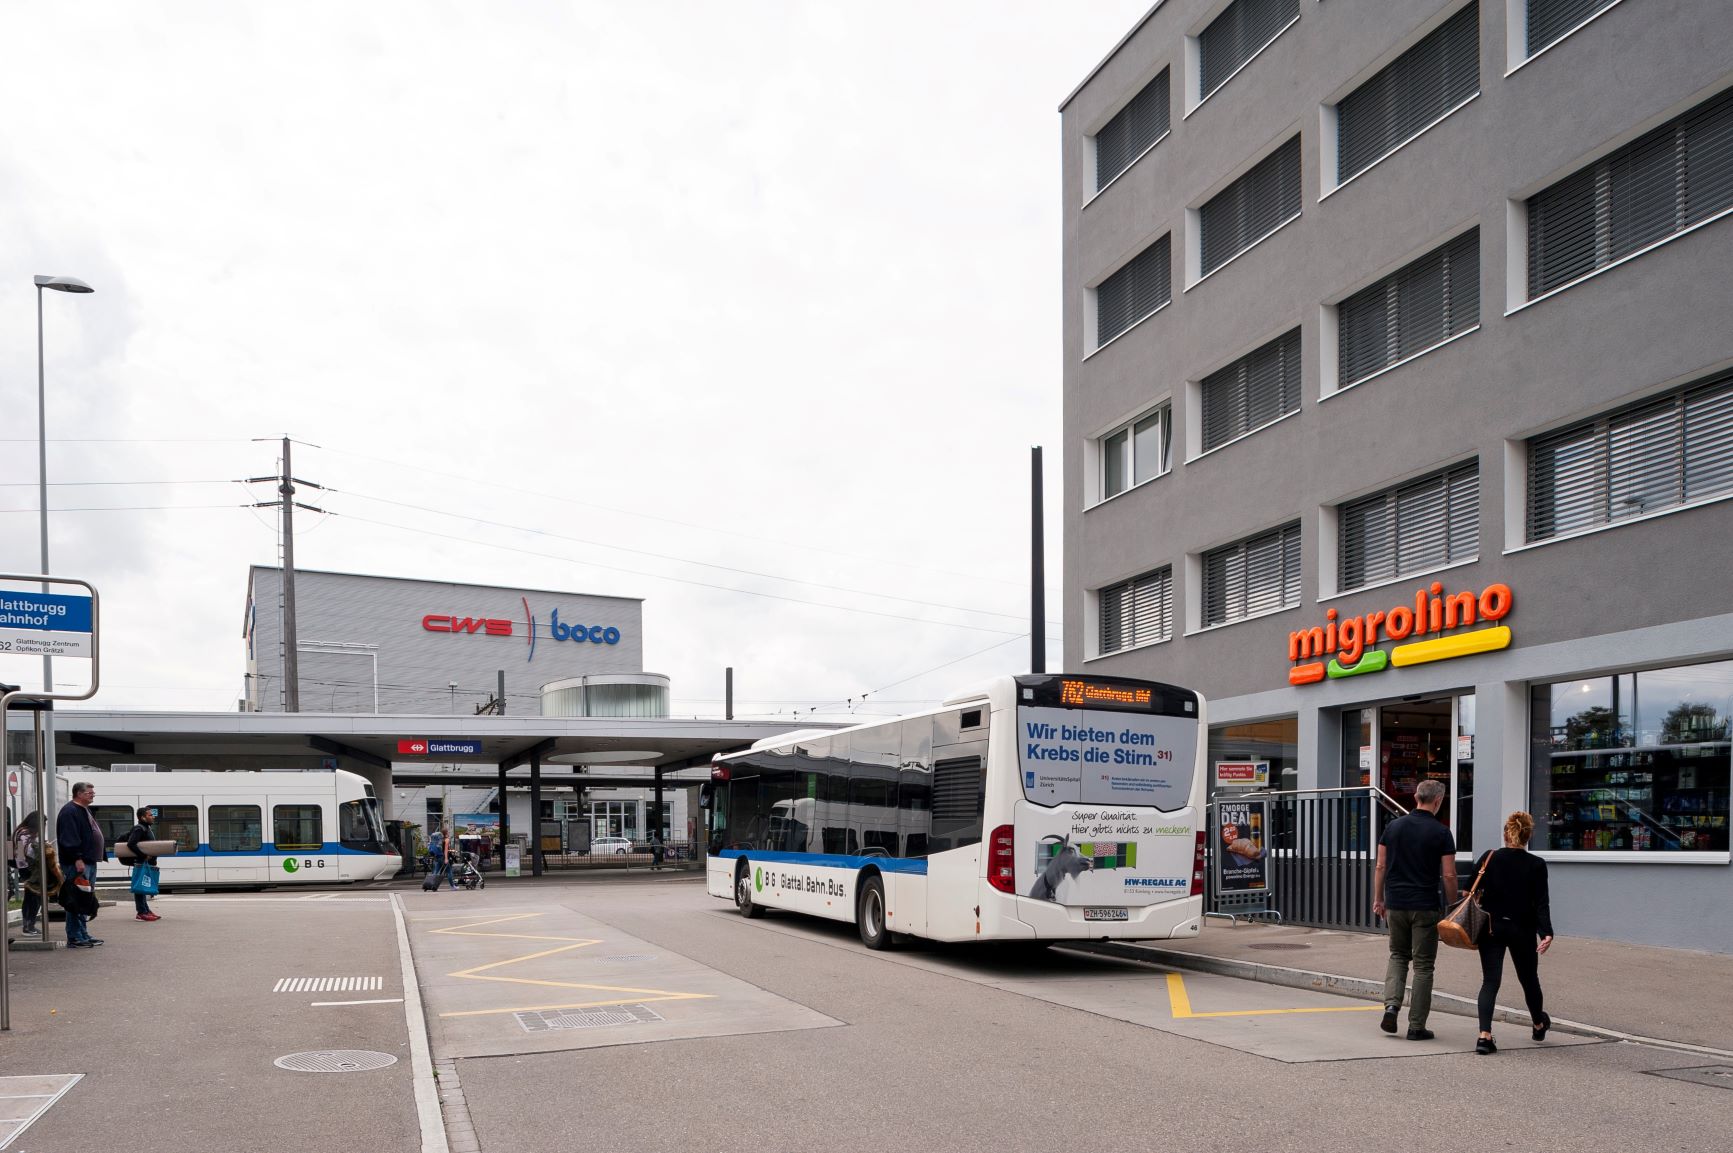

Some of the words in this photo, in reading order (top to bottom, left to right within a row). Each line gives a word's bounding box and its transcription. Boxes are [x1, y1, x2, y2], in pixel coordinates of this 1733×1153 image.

[0, 599, 66, 615] lattbrugg
[0, 613, 48, 625] ahnhof
[1289, 581, 1513, 664] migrolino
[422, 614, 513, 636] CWS
[551, 607, 621, 645] boco
[0, 641, 11, 651] 62
[16, 638, 51, 647] Glattbrugg
[16, 645, 41, 653] Opfikon
[1061, 681, 1084, 704] 762
[1027, 722, 1058, 740] Wir
[1061, 725, 1115, 743] bieten
[1119, 728, 1155, 746] dem
[430, 743, 474, 753] Glattbrugg
[1027, 743, 1080, 762] Krebs
[1083, 747, 1110, 764] die
[1113, 749, 1157, 766] Stirn.
[1157, 750, 1173, 762] 31)
[1221, 804, 1250, 812] ZMORGE
[1071, 811, 1097, 823] Super
[1071, 824, 1089, 834] Hier
[1116, 824, 1139, 834] nichts
[1124, 878, 1174, 887] HW-REGALE
[1174, 879, 1187, 887] AG
